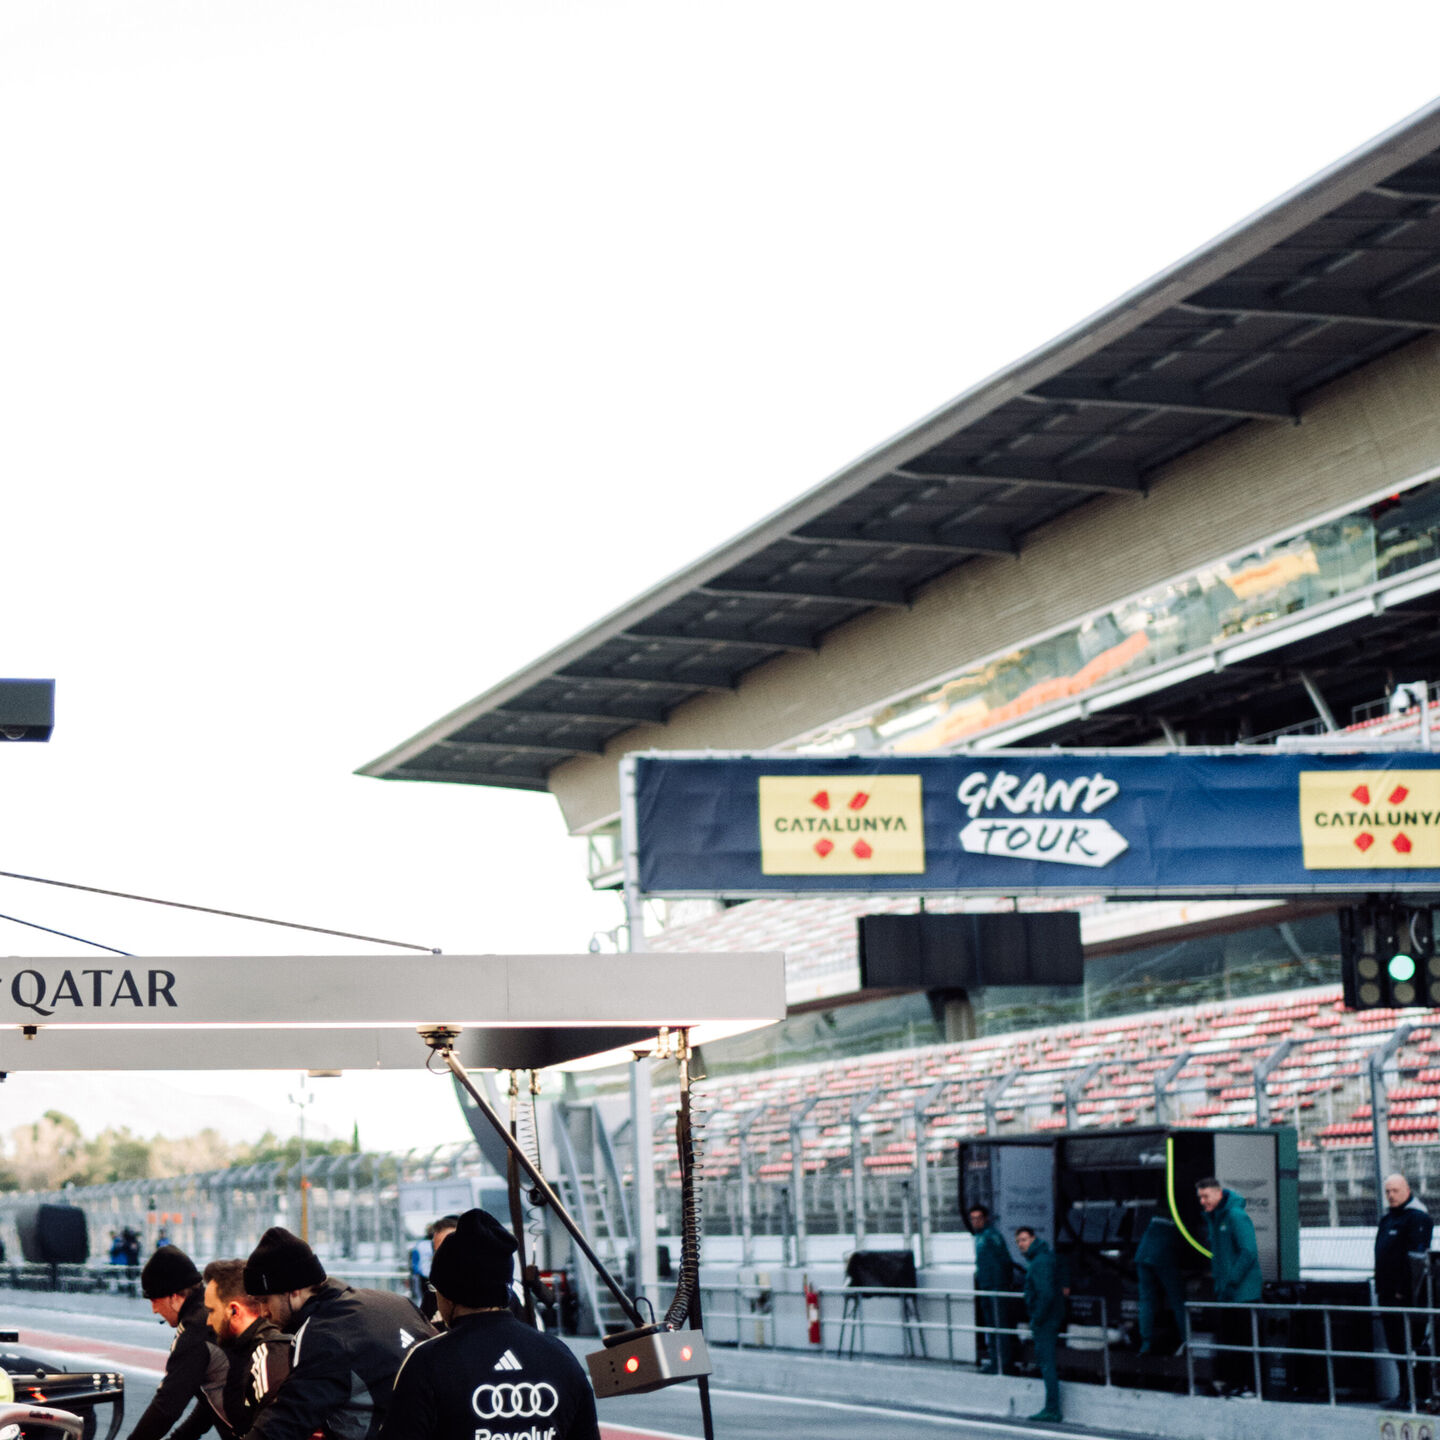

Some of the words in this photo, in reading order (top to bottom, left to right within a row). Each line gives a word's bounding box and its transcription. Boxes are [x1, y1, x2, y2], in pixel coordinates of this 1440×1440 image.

[958, 771, 1120, 818] GRAND
[774, 816, 908, 834] CATALUNYA
[979, 823, 1098, 858] TOUR
